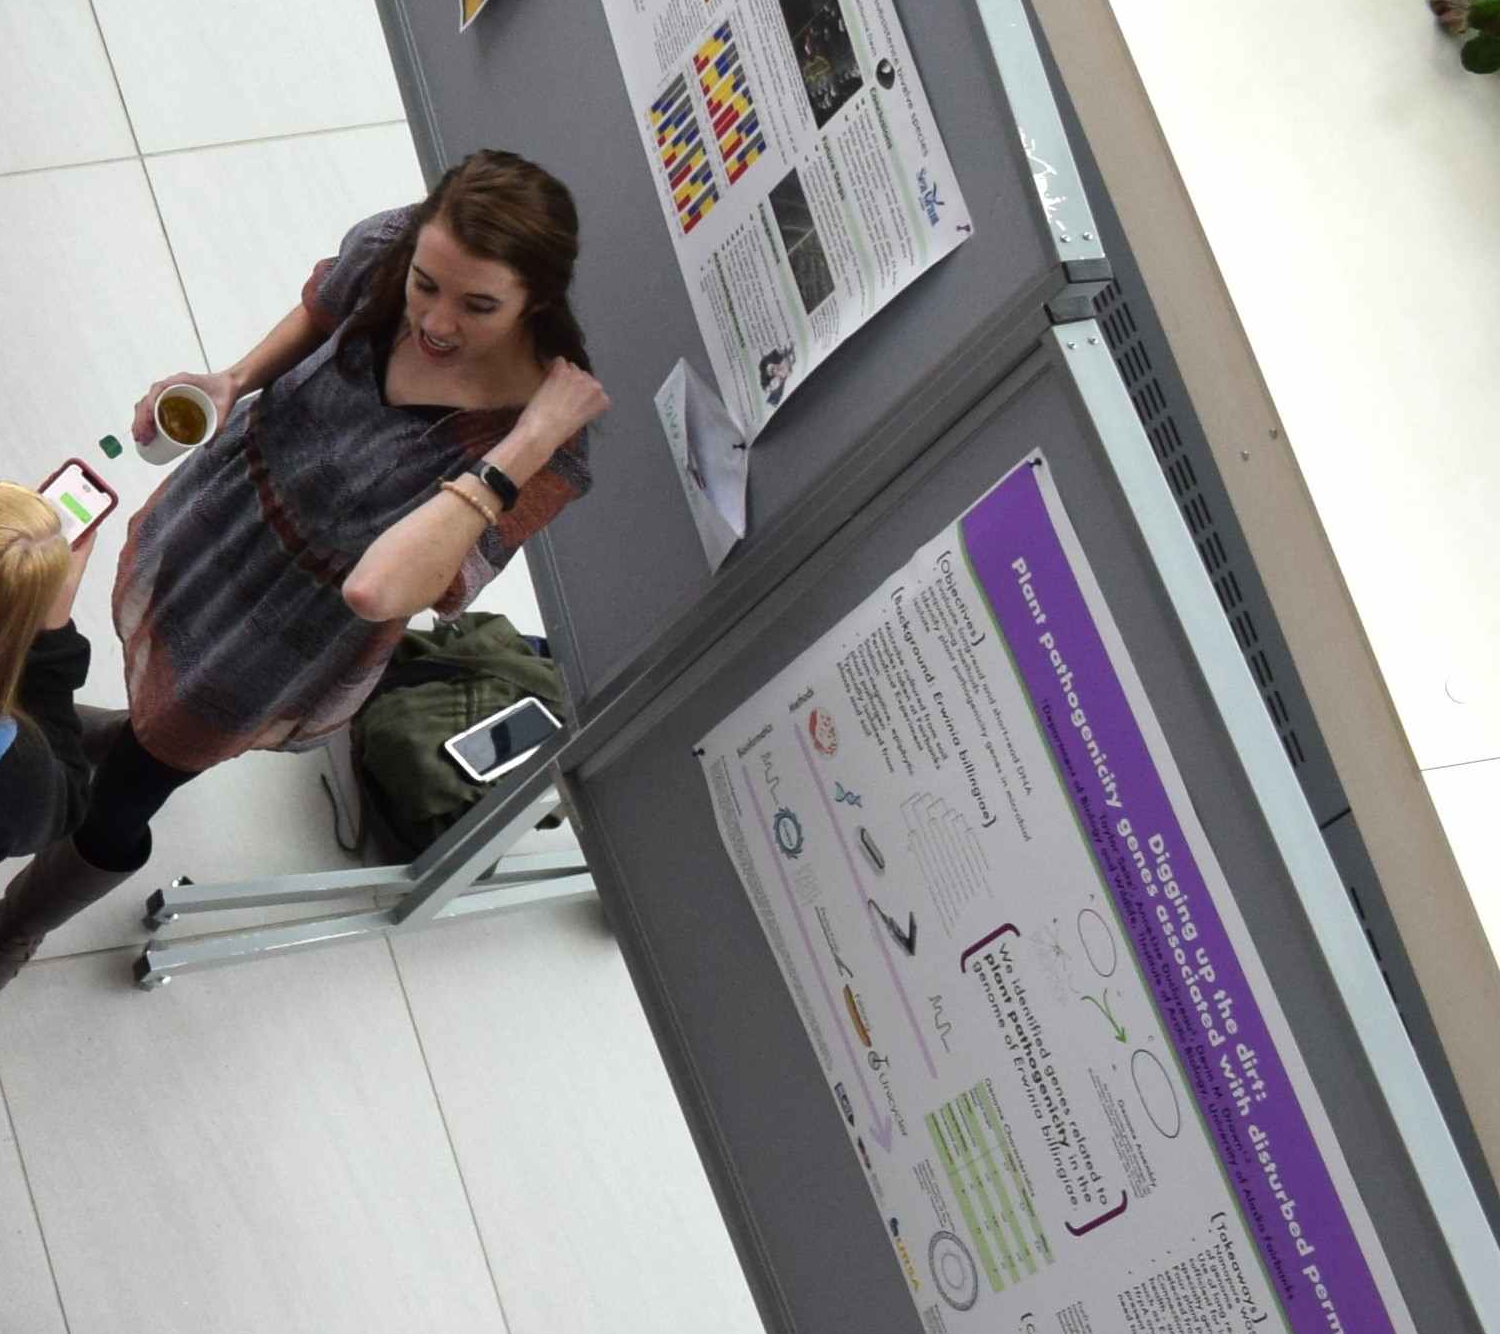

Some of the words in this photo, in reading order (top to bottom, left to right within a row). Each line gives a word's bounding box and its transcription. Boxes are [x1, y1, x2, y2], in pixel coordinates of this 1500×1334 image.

[822, 135, 835, 169] Future
[834, 171, 844, 200] Steps
[871, 87, 892, 149] Conclusions
[758, 203, 780, 264] Engagement
[922, 193, 941, 231] Grant
[1011, 557, 1046, 624] Plant
[1039, 631, 1122, 807] pathogenicity
[1117, 818, 1157, 896] genes
[1156, 905, 1224, 1046] associated
[1219, 1053, 1251, 1115] with
[1248, 1124, 1314, 1256] disturbed
[1148, 834, 1197, 940] Digging
[1195, 947, 1215, 982] up
[1213, 989, 1237, 1033] the
[1235, 1043, 1266, 1100] dirt:
[878, 1072, 908, 1136] Unicycler
[972, 958, 1005, 1028] genome
[1004, 1034, 1019, 1050] of
[1013, 1056, 1042, 1119] Erwinia
[1041, 1125, 1077, 1204] billingiae.
[983, 953, 1011, 1002] plant
[1007, 1010, 1070, 1147] pathogenicity
[1068, 1154, 1077, 1170] in
[1077, 1175, 1091, 1202] the
[998, 942, 1012, 973] We
[1011, 978, 1051, 1058] identified
[1043, 1064, 1070, 1115] genes
[1070, 1121, 1100, 1182] related
[1096, 1187, 1107, 1205] to
[984, 1077, 1004, 1120] Genome
[1003, 1123, 1035, 1197] Characteristics
